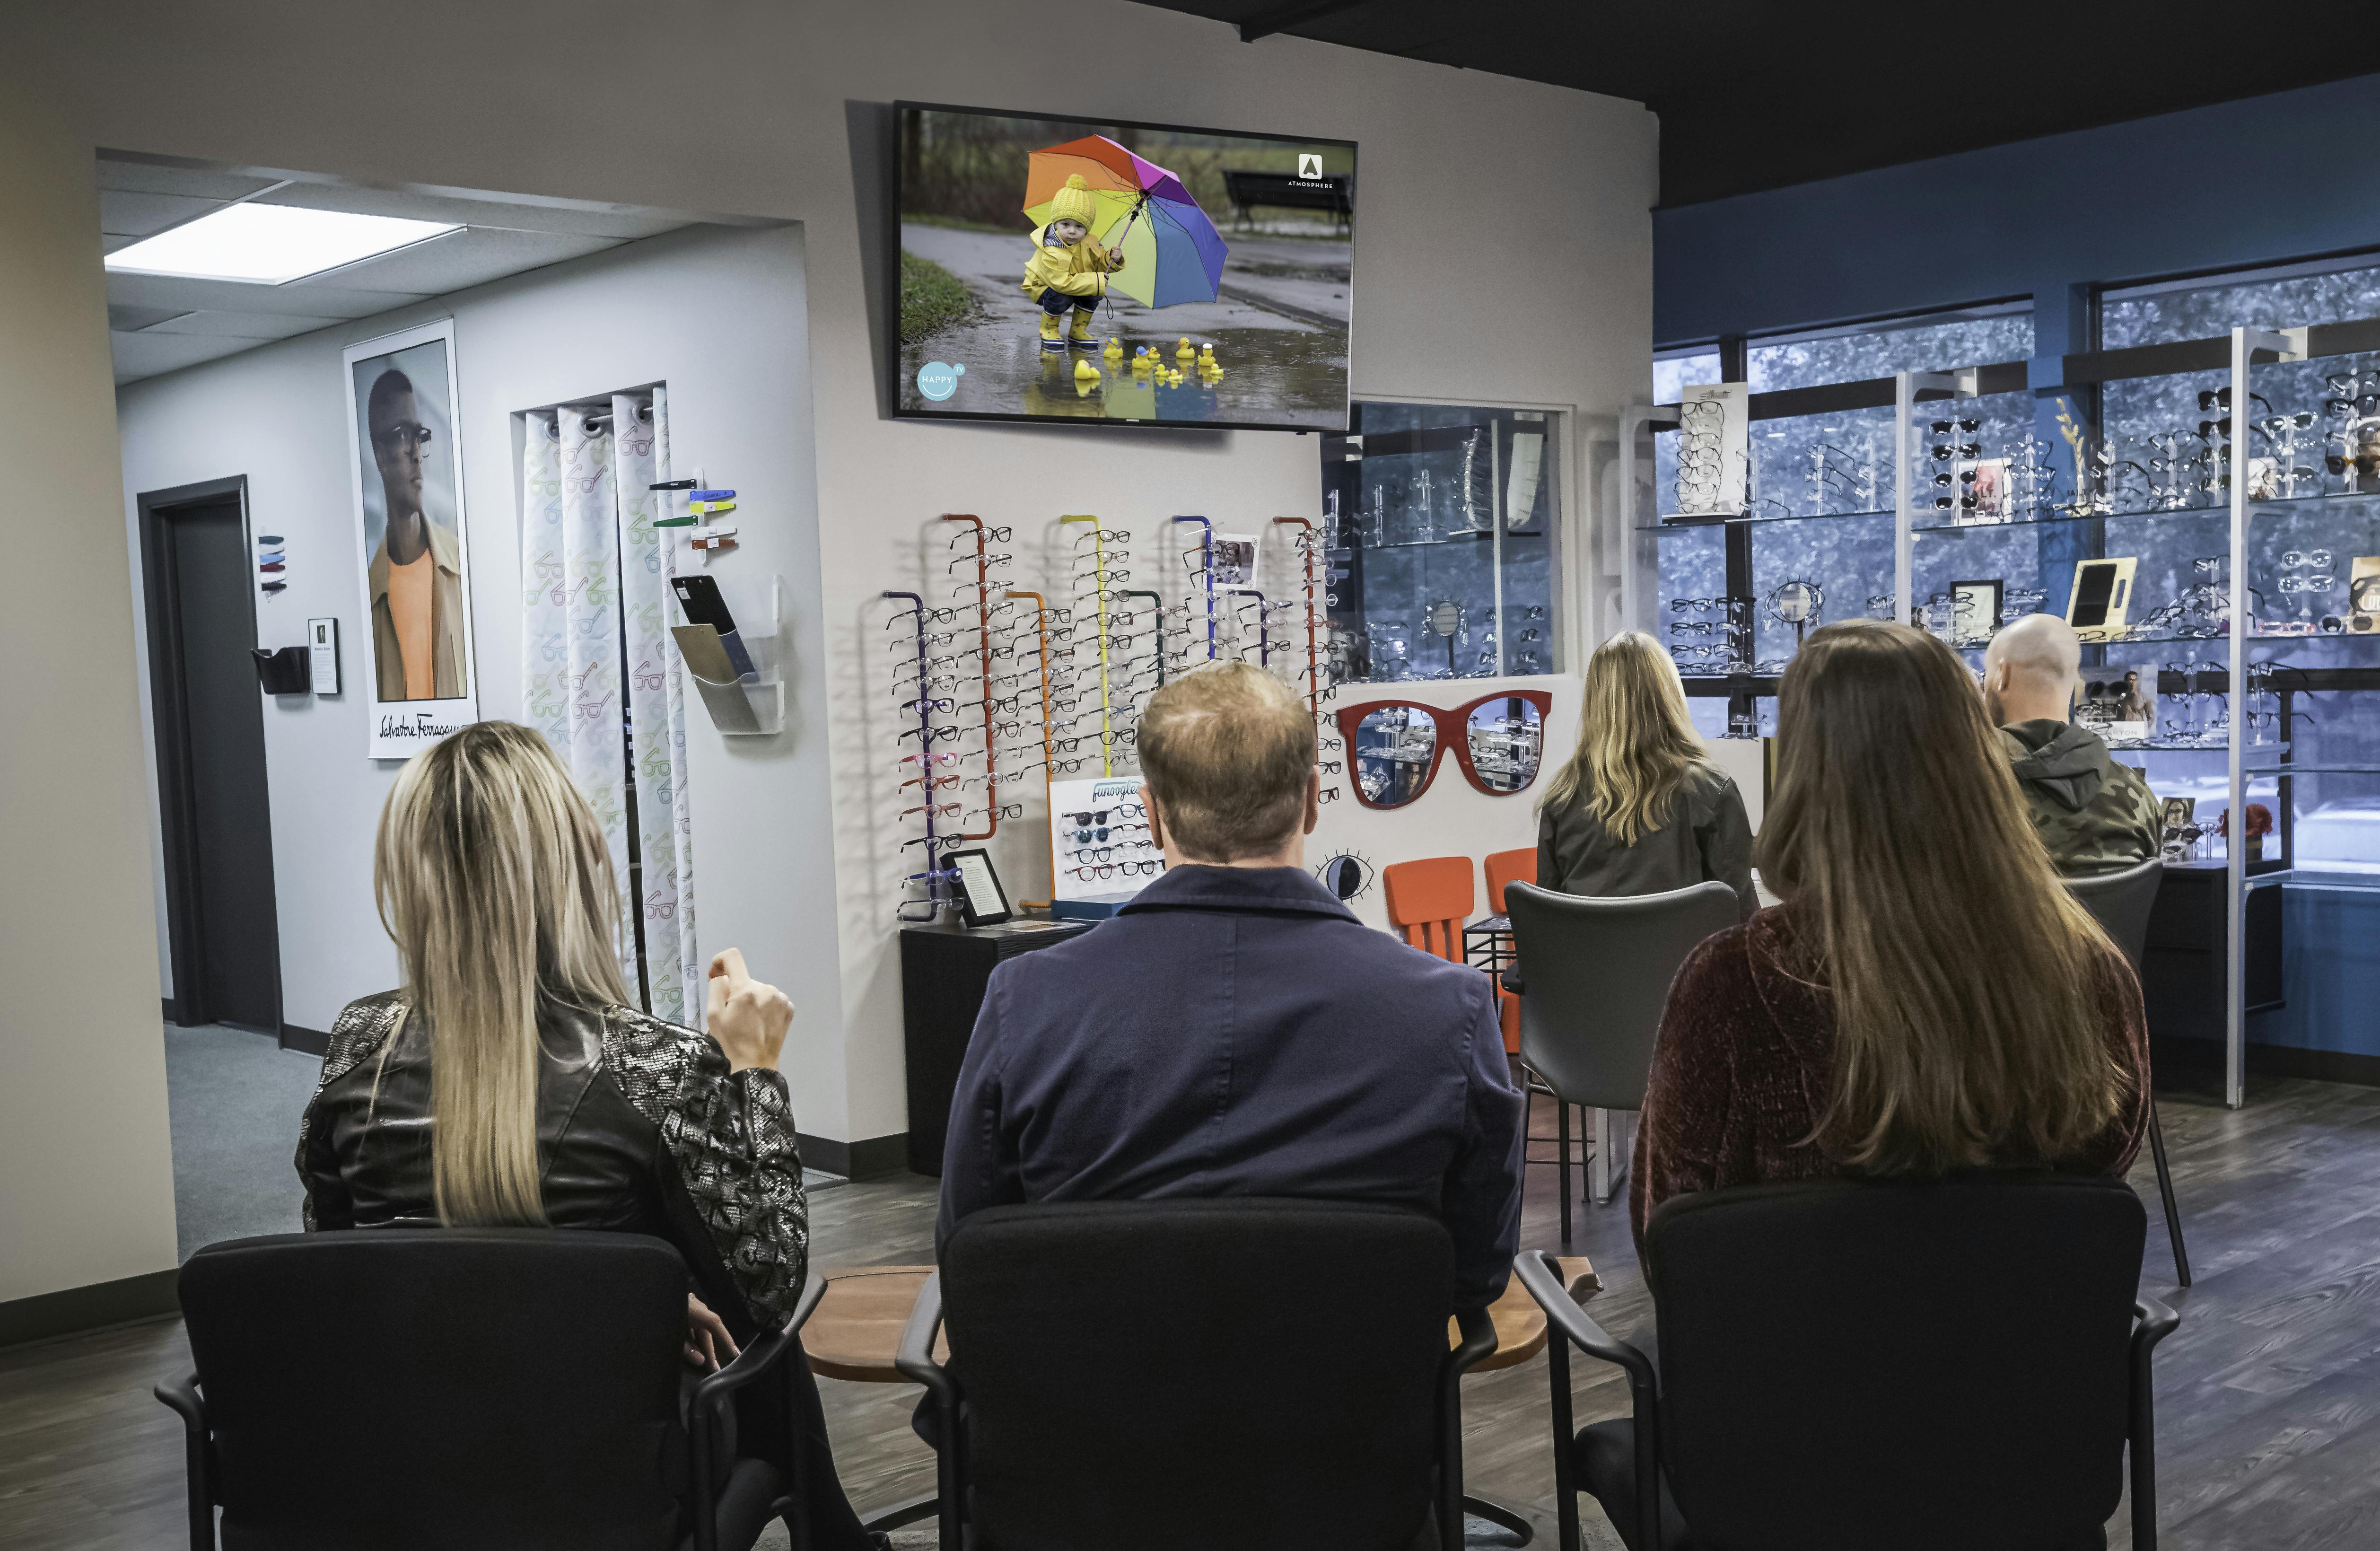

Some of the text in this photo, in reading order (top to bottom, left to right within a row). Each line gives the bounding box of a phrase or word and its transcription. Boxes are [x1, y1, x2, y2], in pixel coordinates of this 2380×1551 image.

[1288, 181, 1333, 189] ATMOSPHERE
[922, 376, 952, 384] HAPPY
[379, 713, 470, 739] Salvatore Ferragam
